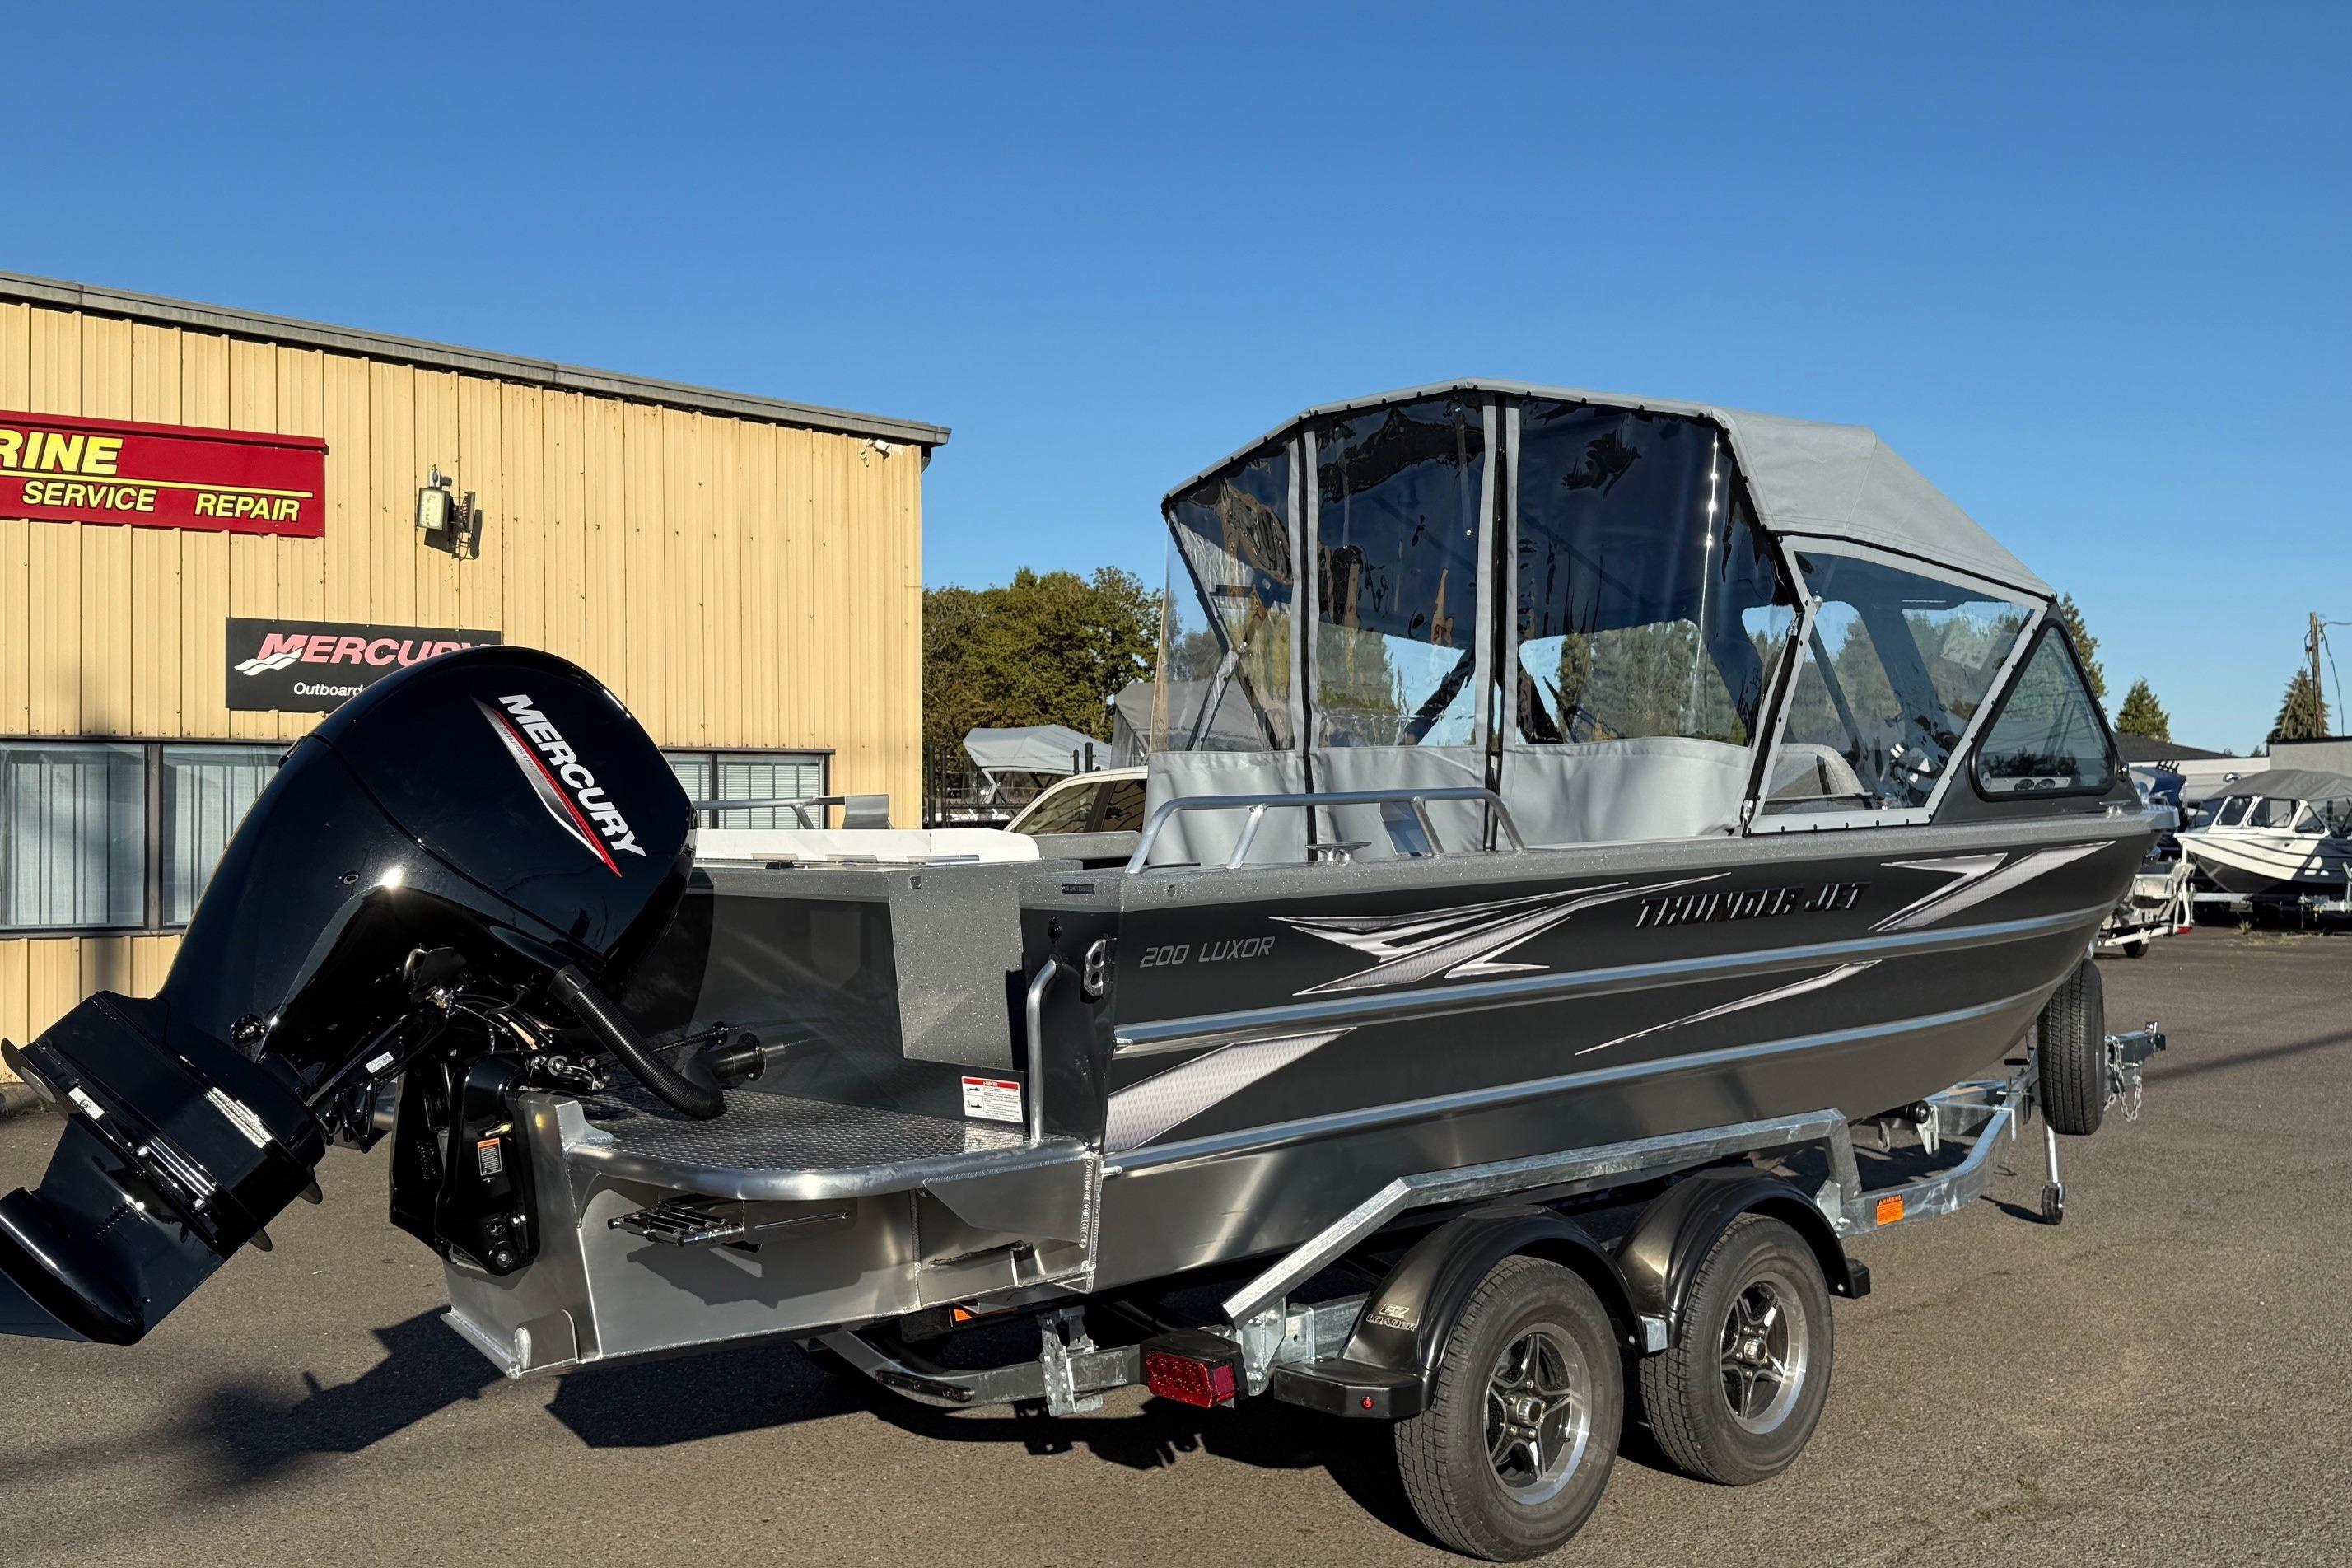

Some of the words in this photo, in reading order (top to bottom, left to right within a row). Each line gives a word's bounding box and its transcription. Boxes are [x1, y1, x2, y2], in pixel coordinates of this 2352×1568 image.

[22, 481, 157, 511] SERVICE
[194, 493, 301, 522] REPAIR
[498, 694, 647, 857] MERCURY
[1140, 944, 1190, 968] 200
[1198, 936, 1276, 963] LUXOR
[1365, 1314, 1418, 1332] LOADER
